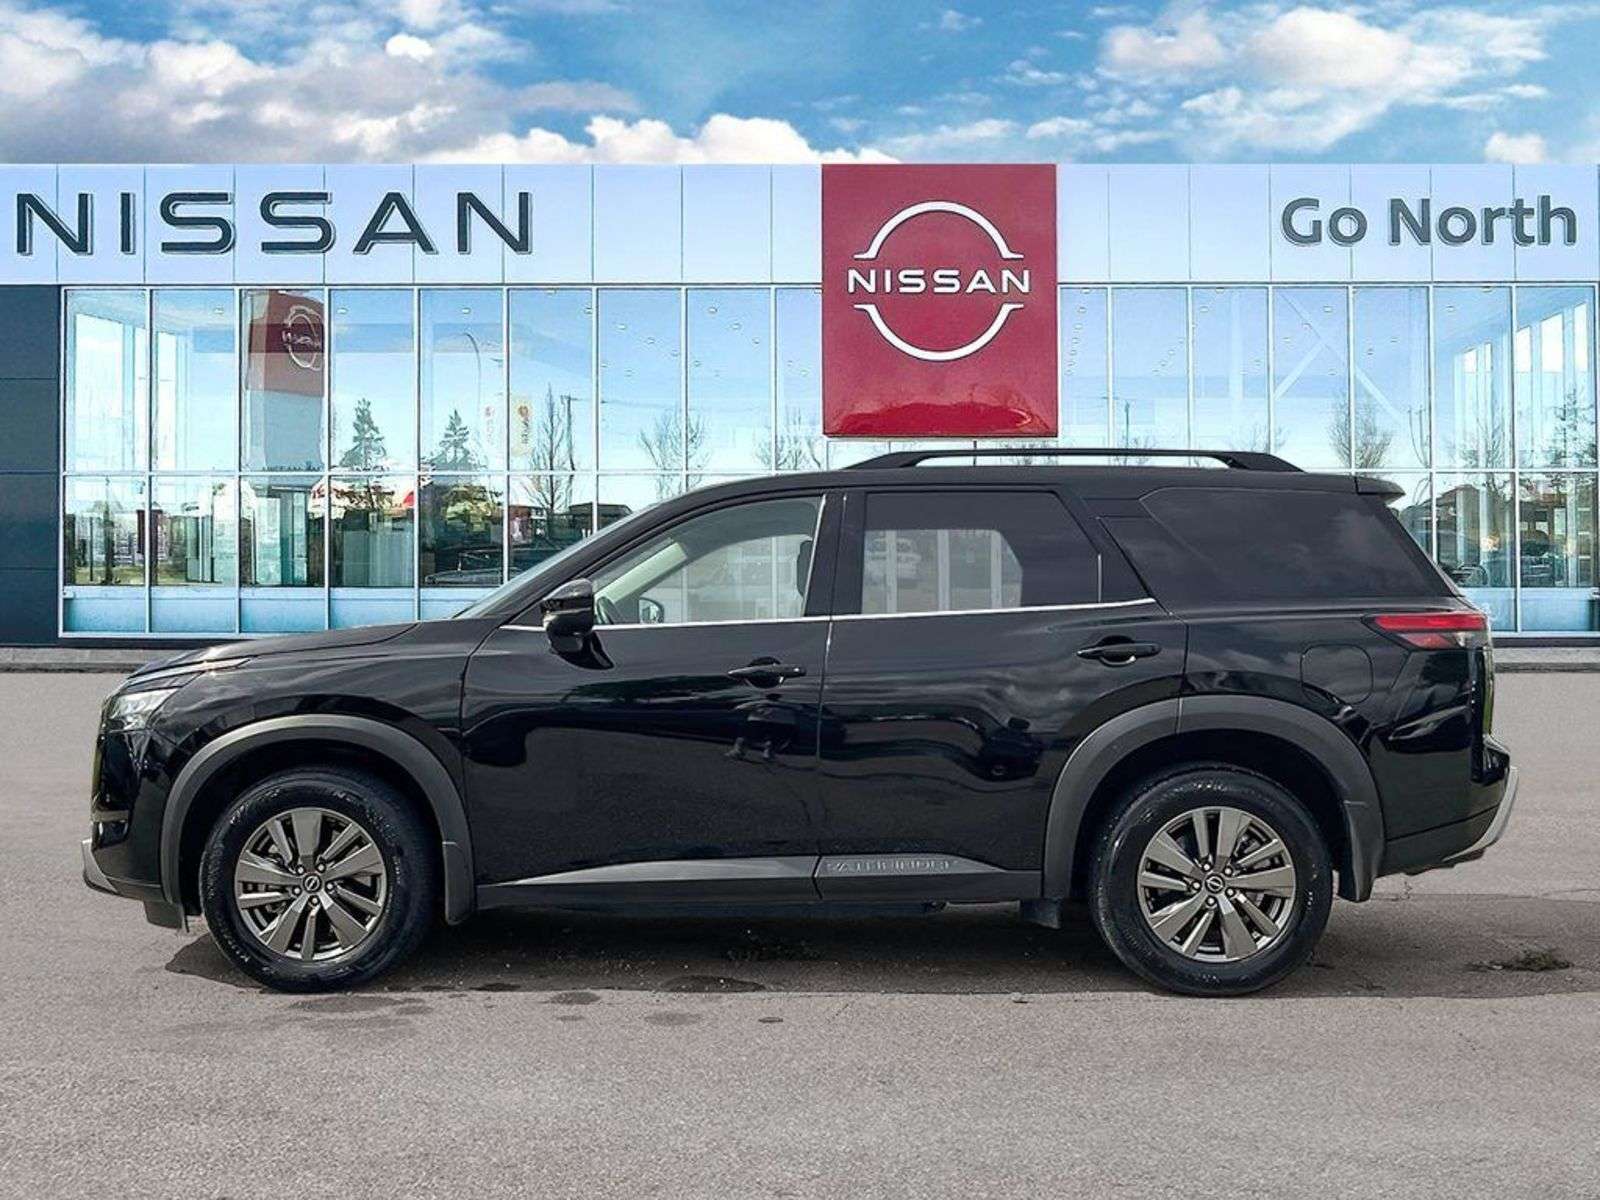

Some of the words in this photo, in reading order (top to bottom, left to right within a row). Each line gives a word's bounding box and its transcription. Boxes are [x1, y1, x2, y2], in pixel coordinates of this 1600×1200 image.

[17, 192, 532, 254] NISSAN
[1282, 197, 1367, 245] Go
[1389, 195, 1577, 246] North
[848, 269, 1031, 293] NISSAN
